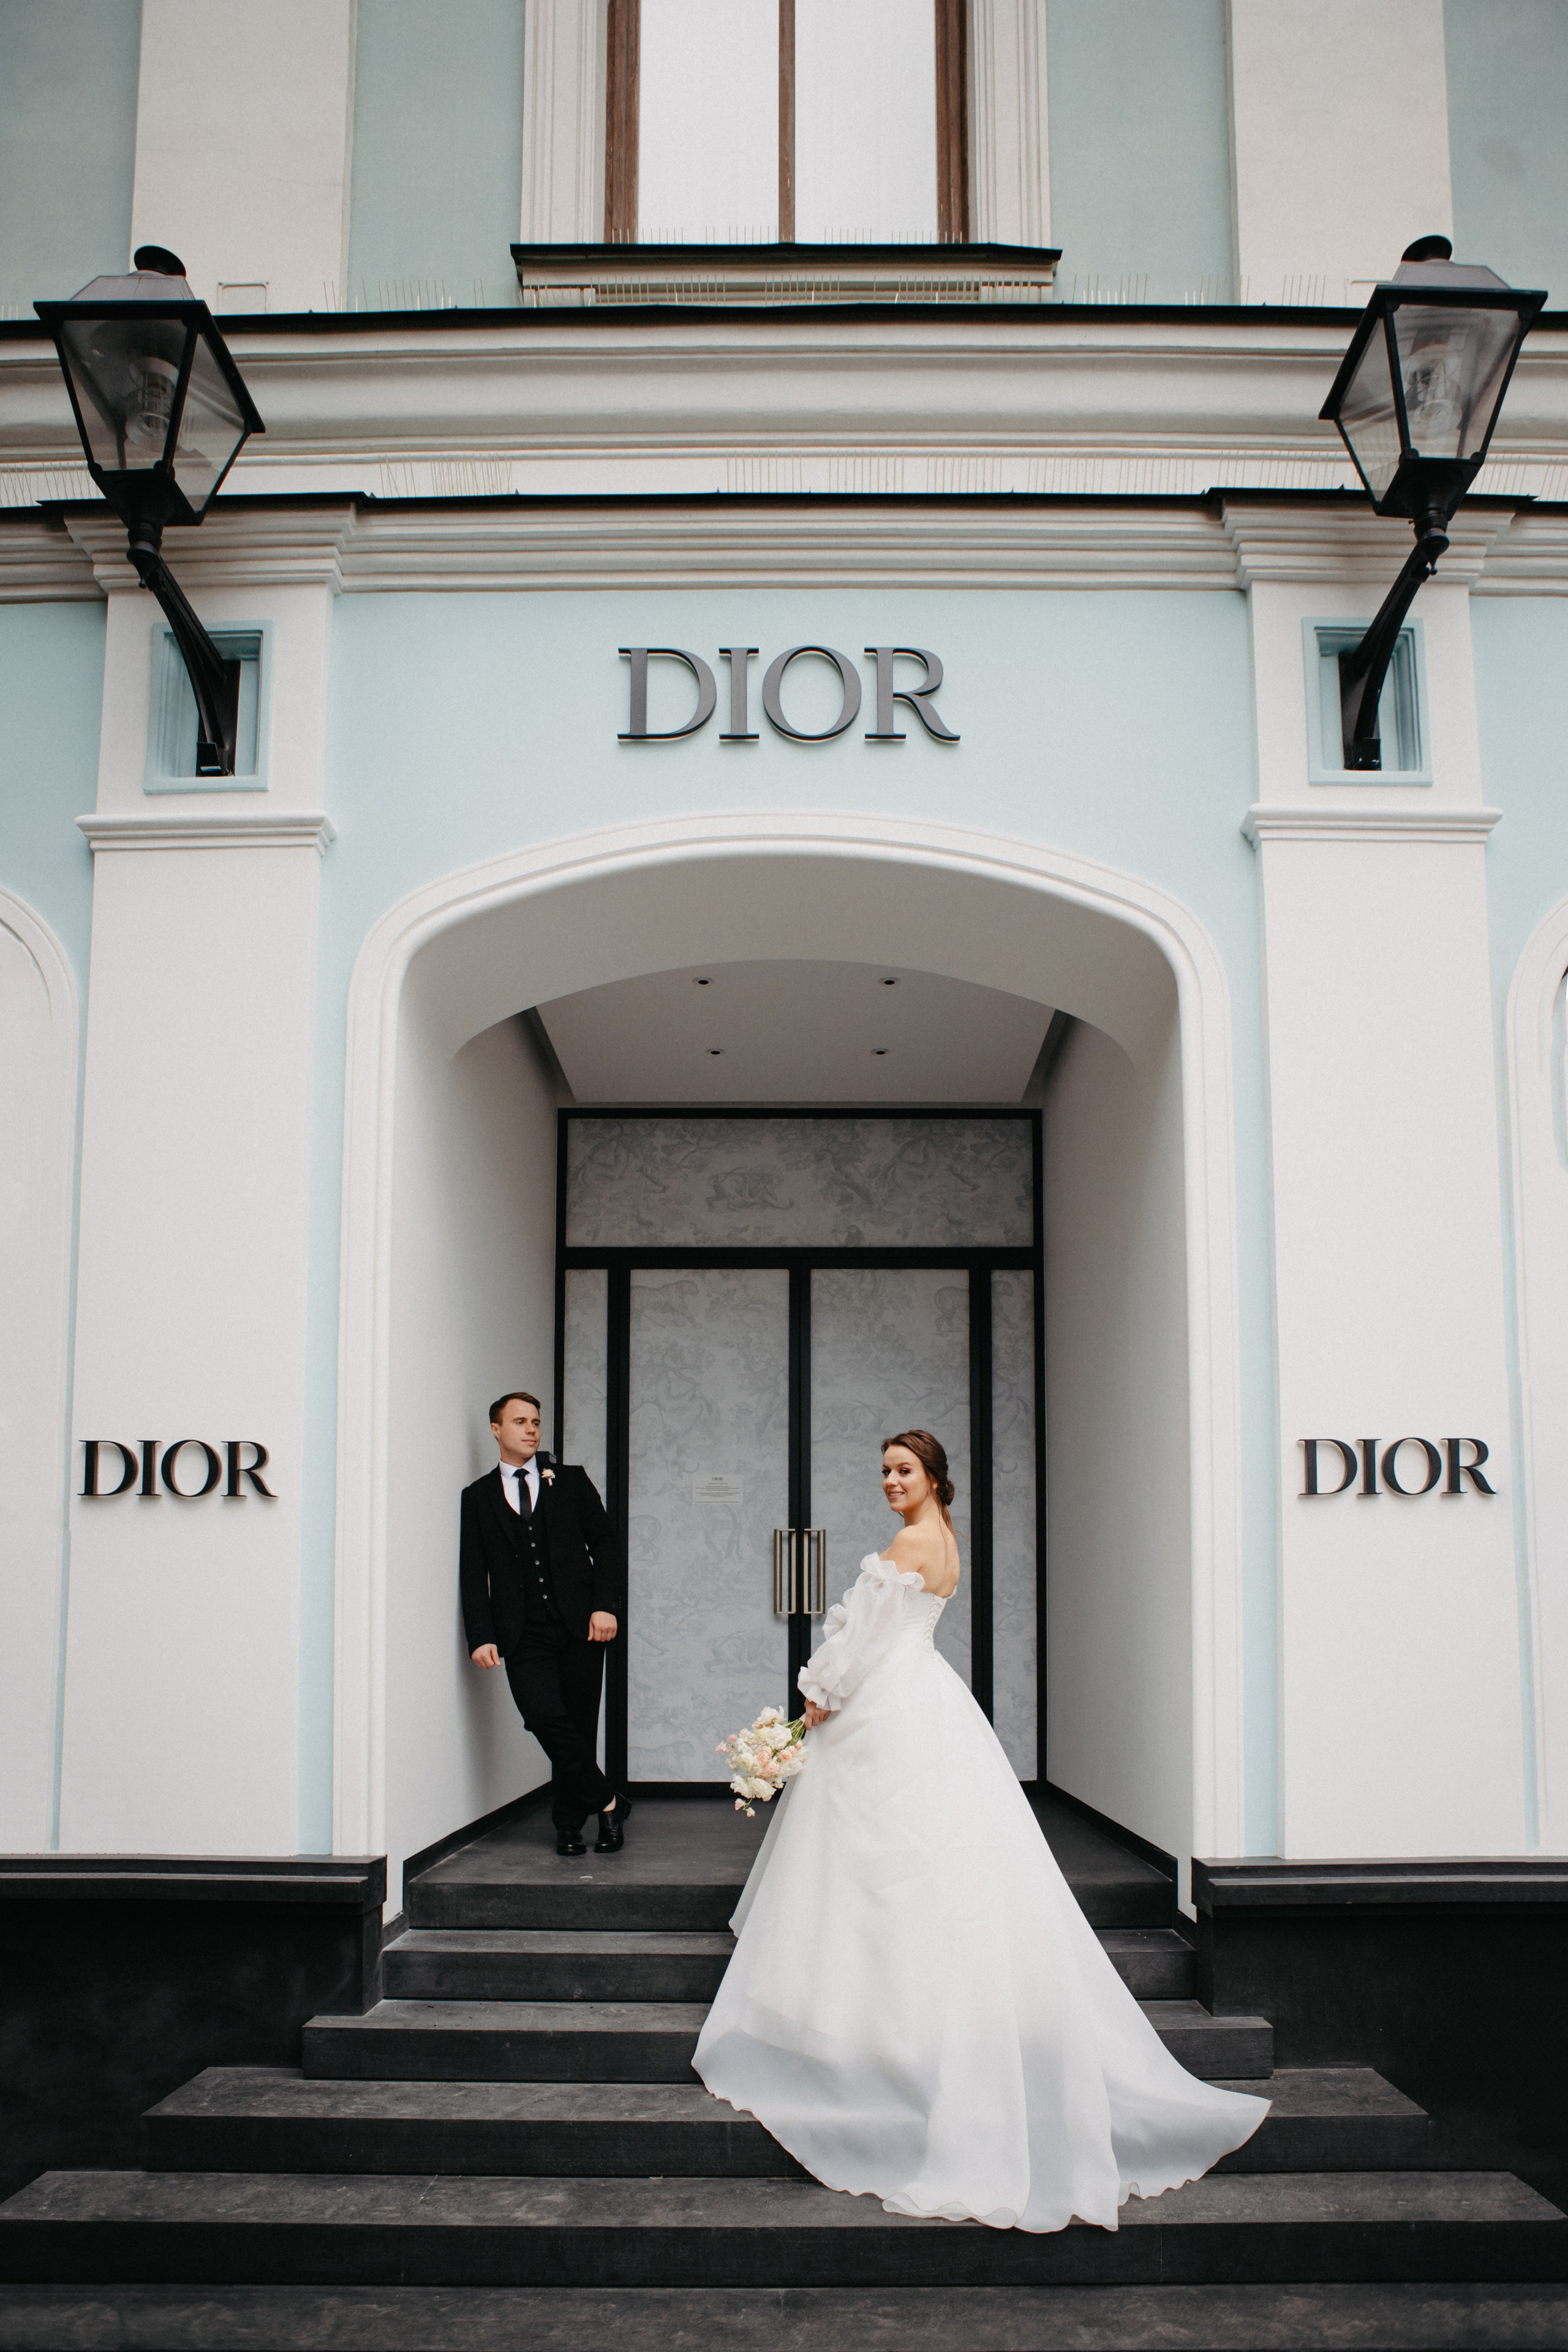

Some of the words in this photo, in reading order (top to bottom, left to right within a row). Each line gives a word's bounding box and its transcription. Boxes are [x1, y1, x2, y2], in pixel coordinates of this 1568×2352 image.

[617, 646, 960, 742] DIOR
[77, 1439, 278, 1498] DIOR
[1298, 1438, 1496, 1496] DIOR
